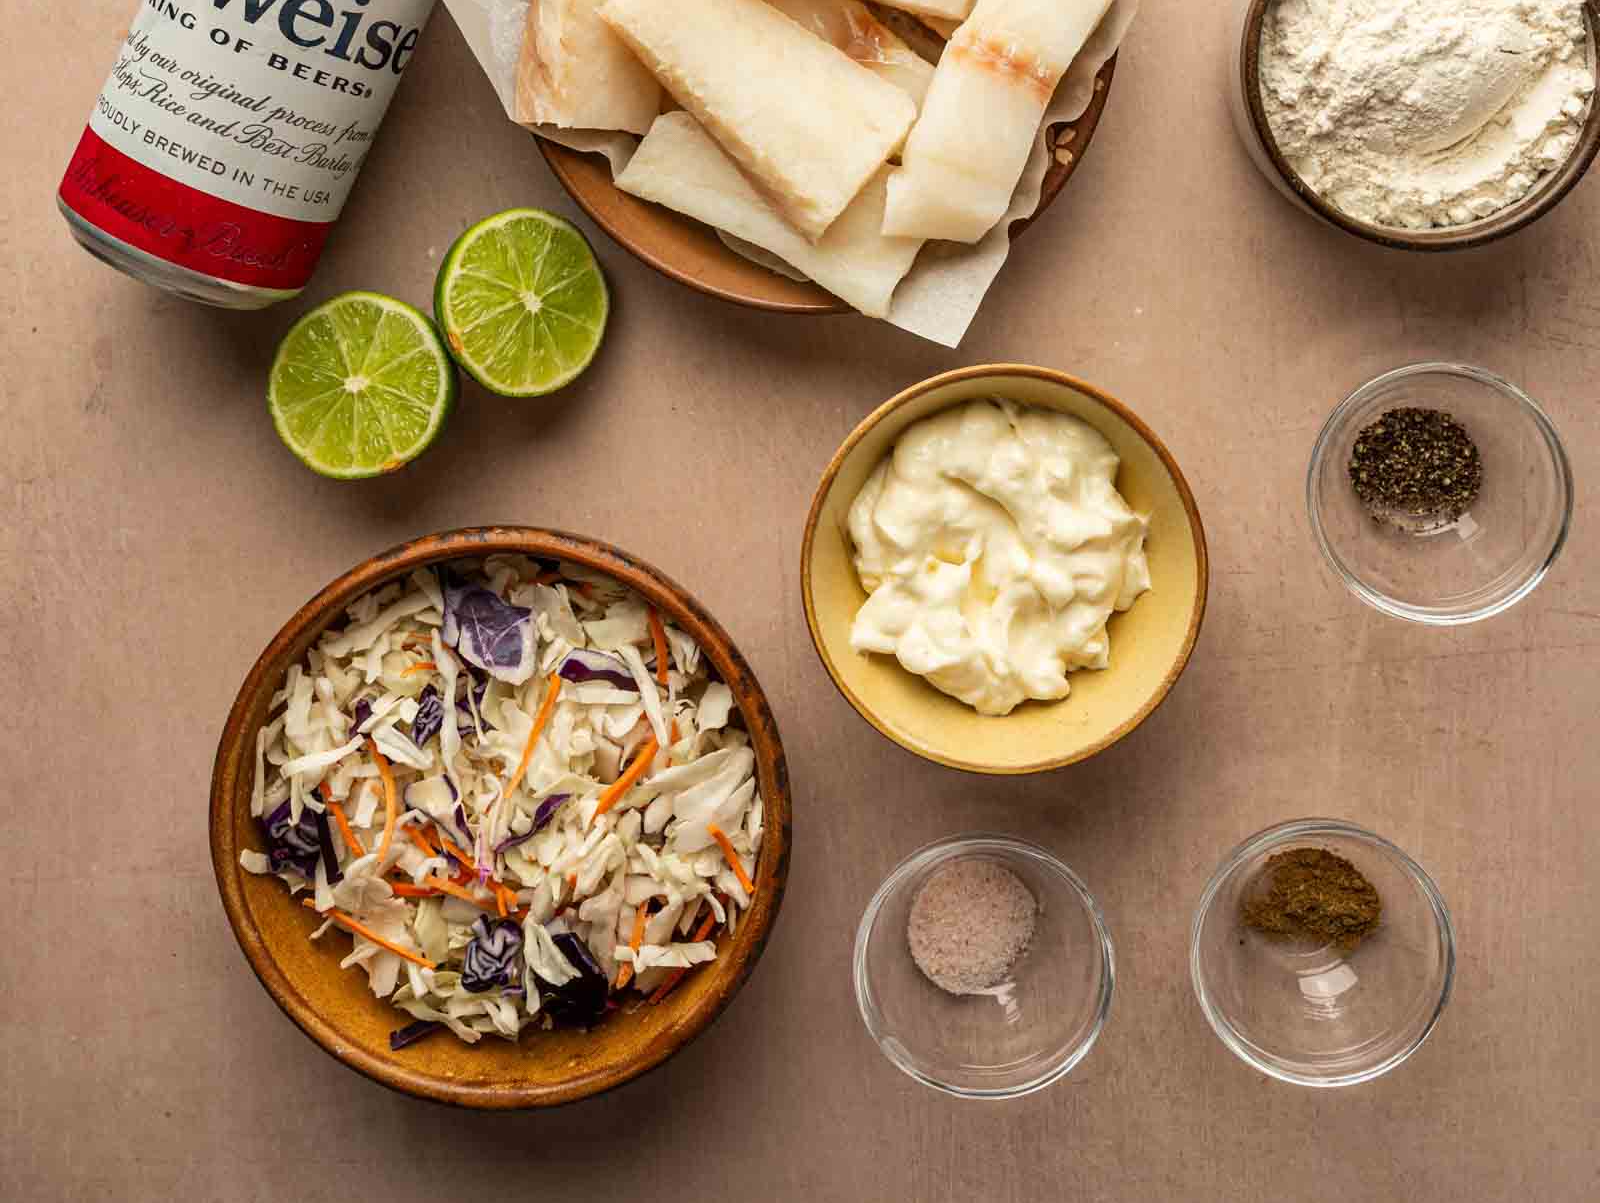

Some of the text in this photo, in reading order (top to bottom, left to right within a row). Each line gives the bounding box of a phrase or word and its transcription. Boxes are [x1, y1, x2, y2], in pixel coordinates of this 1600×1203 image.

[210, 28, 254, 54] OF
[132, 34, 150, 63] by
[150, 52, 180, 74] our
[180, 70, 272, 112] original
[261, 105, 337, 137] process
[138, 66, 188, 116] Rice
[187, 112, 240, 138] and
[233, 124, 300, 159] Best
[143, 129, 226, 176] BREWED
[232, 168, 255, 186] IN
[263, 178, 300, 199] THE
[303, 189, 331, 205] USA
